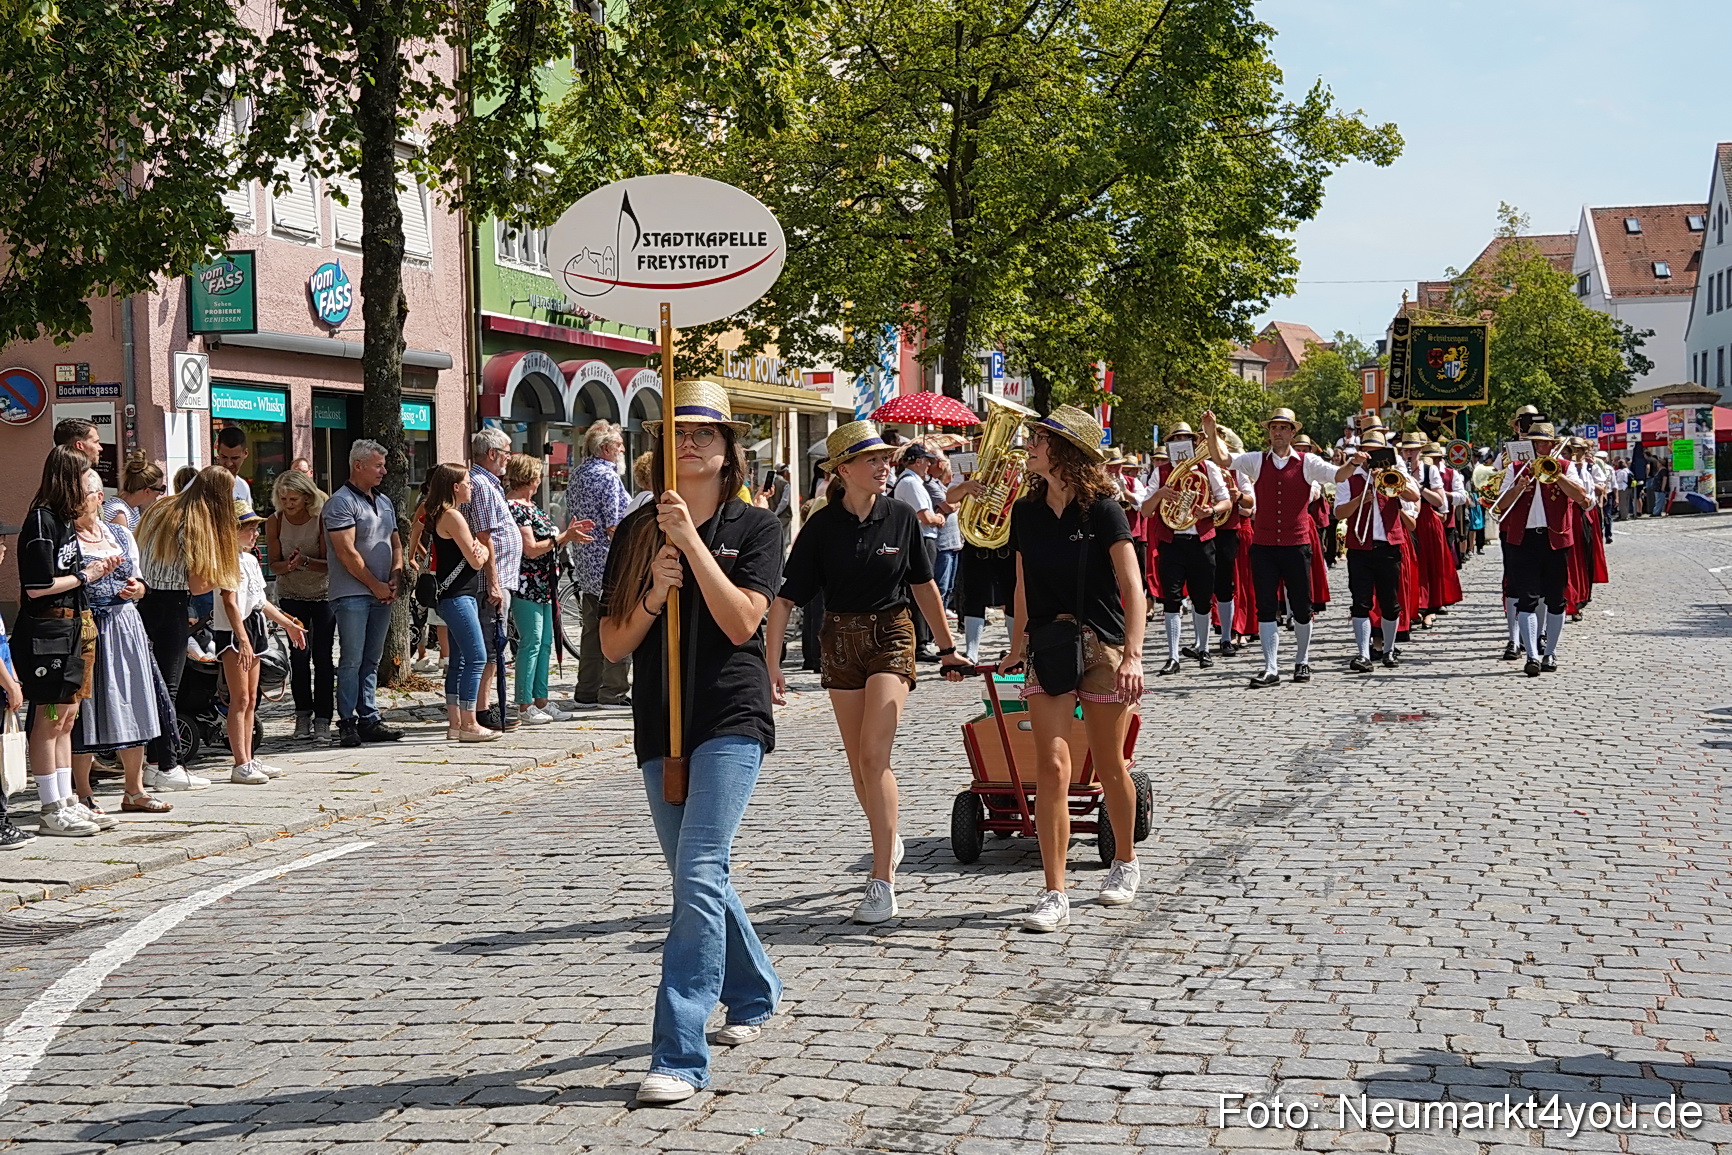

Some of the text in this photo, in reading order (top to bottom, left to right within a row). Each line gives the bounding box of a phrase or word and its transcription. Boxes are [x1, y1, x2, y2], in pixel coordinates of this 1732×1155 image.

[642, 231, 768, 248] STADTKAPELLE
[637, 254, 730, 271] FREYSTADT
[199, 266, 223, 283] vom
[208, 270, 244, 294] FASS
[310, 269, 333, 293] vom
[319, 282, 352, 318] FASS
[529, 293, 562, 312] METZGEREI
[58, 384, 119, 397] Bockwirtsgasse
[184, 396, 201, 406] ZONE
[211, 392, 285, 417] Spirituosen Whisky
[92, 416, 112, 424] SUNNY
[314, 405, 341, 420] Feinkost
[418, 406, 427, 422] Öl
[1587, 426, 1596, 438] P
[1629, 420, 1639, 432] P
